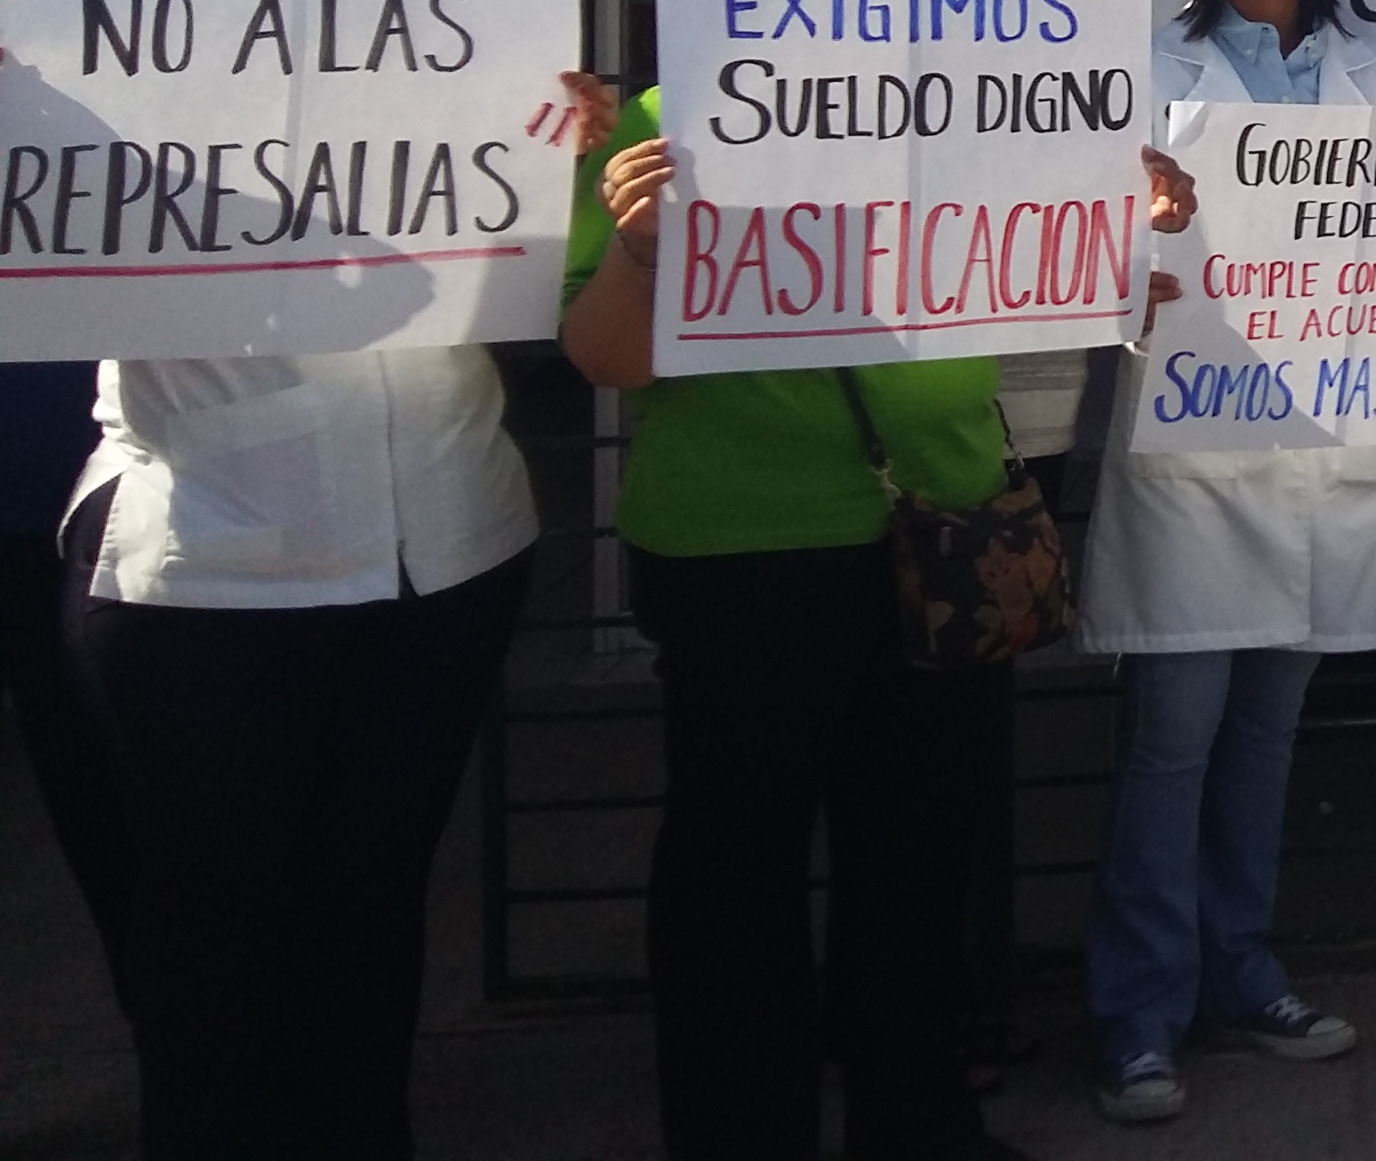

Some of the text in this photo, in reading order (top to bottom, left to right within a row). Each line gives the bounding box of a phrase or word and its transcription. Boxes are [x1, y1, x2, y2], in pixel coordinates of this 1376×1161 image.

[709, 58, 1133, 145] SUELDO DIGNO
[0, 138, 519, 256] REPRESALIAS
[682, 194, 1135, 323] BASIFICACION
[1204, 254, 1320, 299] CUMPLE
[1247, 311, 1283, 341] EL
[1154, 351, 1294, 423] SOMOS
